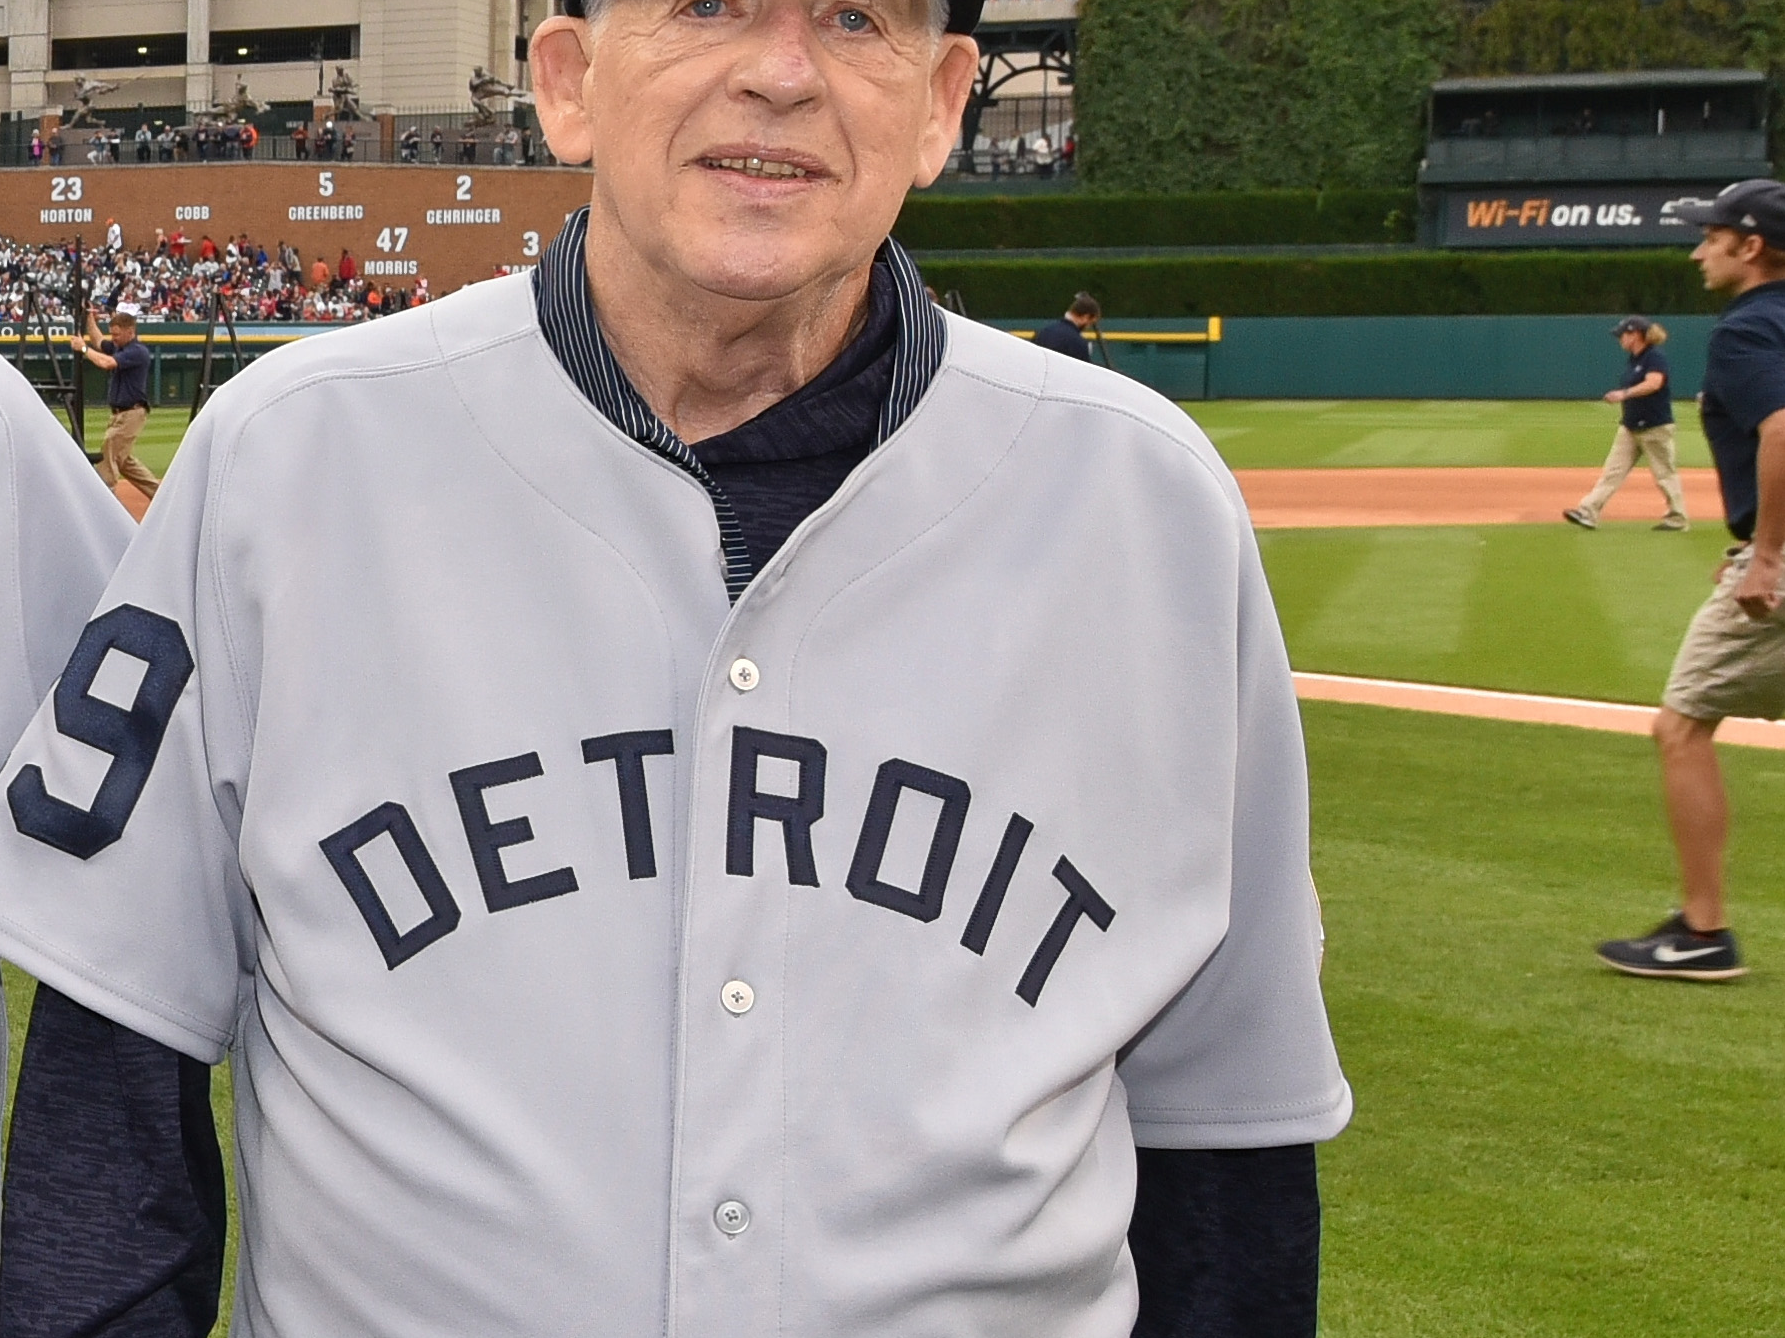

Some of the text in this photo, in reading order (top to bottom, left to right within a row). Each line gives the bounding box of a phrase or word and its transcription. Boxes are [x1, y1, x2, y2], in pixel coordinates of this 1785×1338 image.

[51, 176, 83, 201] 23
[319, 172, 334, 197] 5
[456, 175, 472, 201] 2
[40, 208, 93, 223] HORTON
[175, 206, 210, 220] COBB
[288, 205, 364, 221] GREENBERG
[426, 208, 501, 225] GEHRINGER
[1467, 198, 1644, 228] Wi-Fi on us.
[376, 227, 409, 252] 47
[522, 231, 540, 256] 3
[364, 260, 418, 275] MORRIS
[6, 603, 195, 860] 9
[319, 725, 1116, 1008] DETROIT
